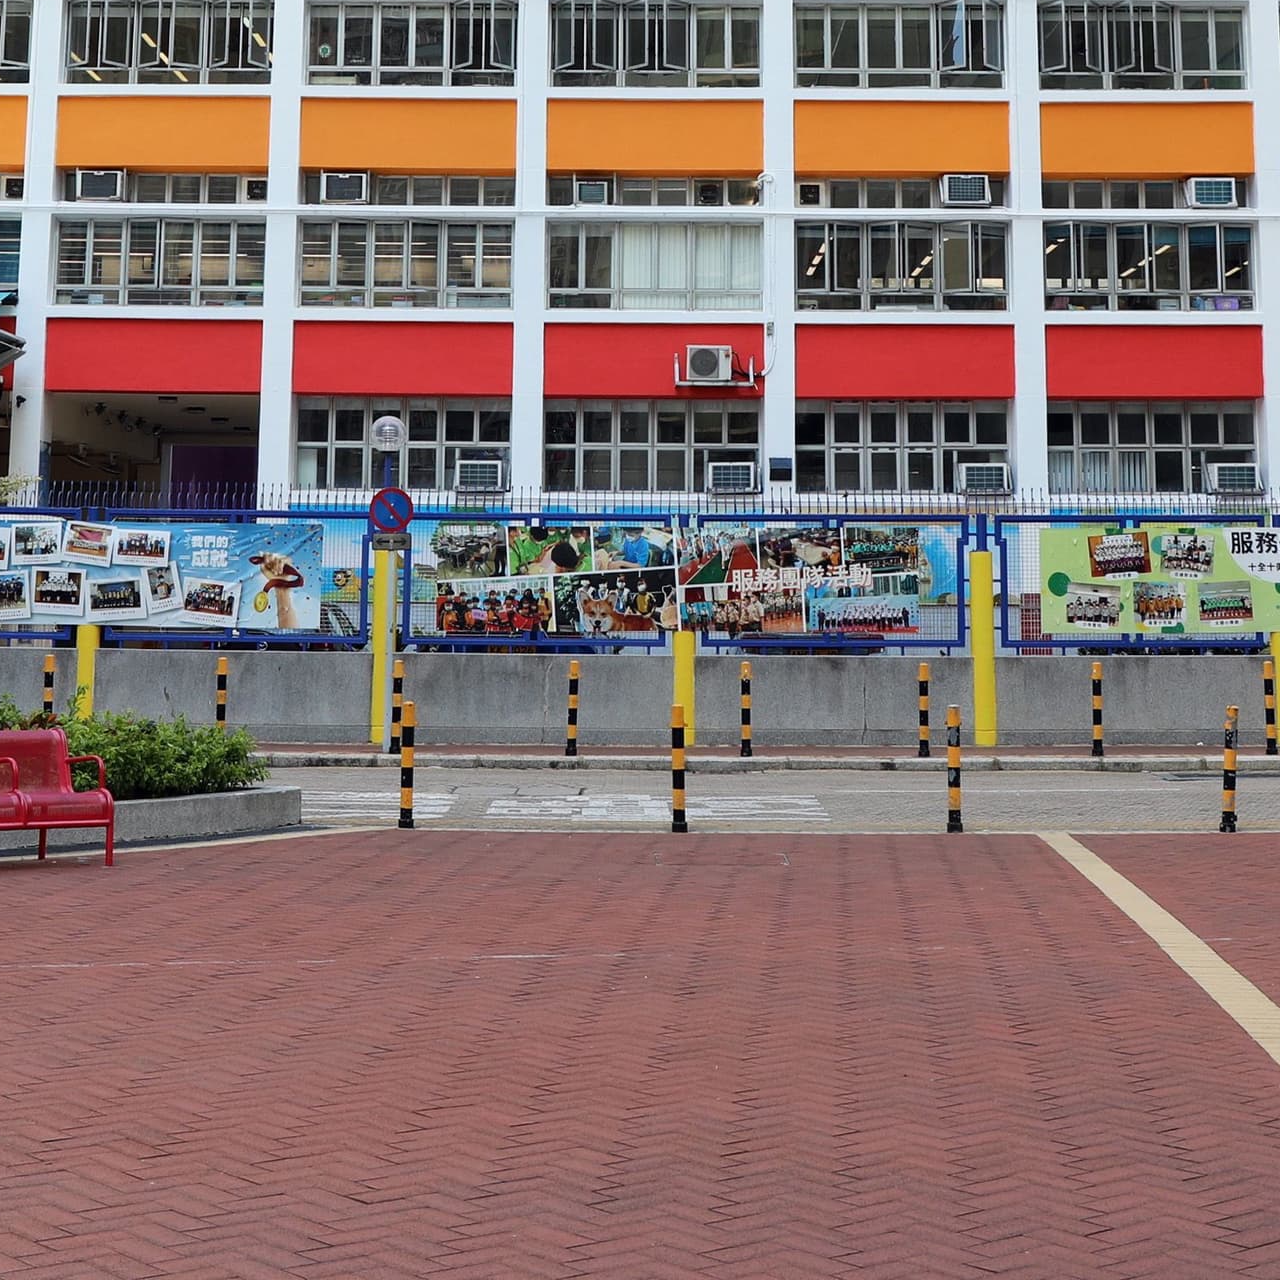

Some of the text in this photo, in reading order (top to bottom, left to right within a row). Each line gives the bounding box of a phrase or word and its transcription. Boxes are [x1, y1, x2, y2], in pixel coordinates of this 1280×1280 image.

[731, 562, 873, 594] 服務團隊活動
